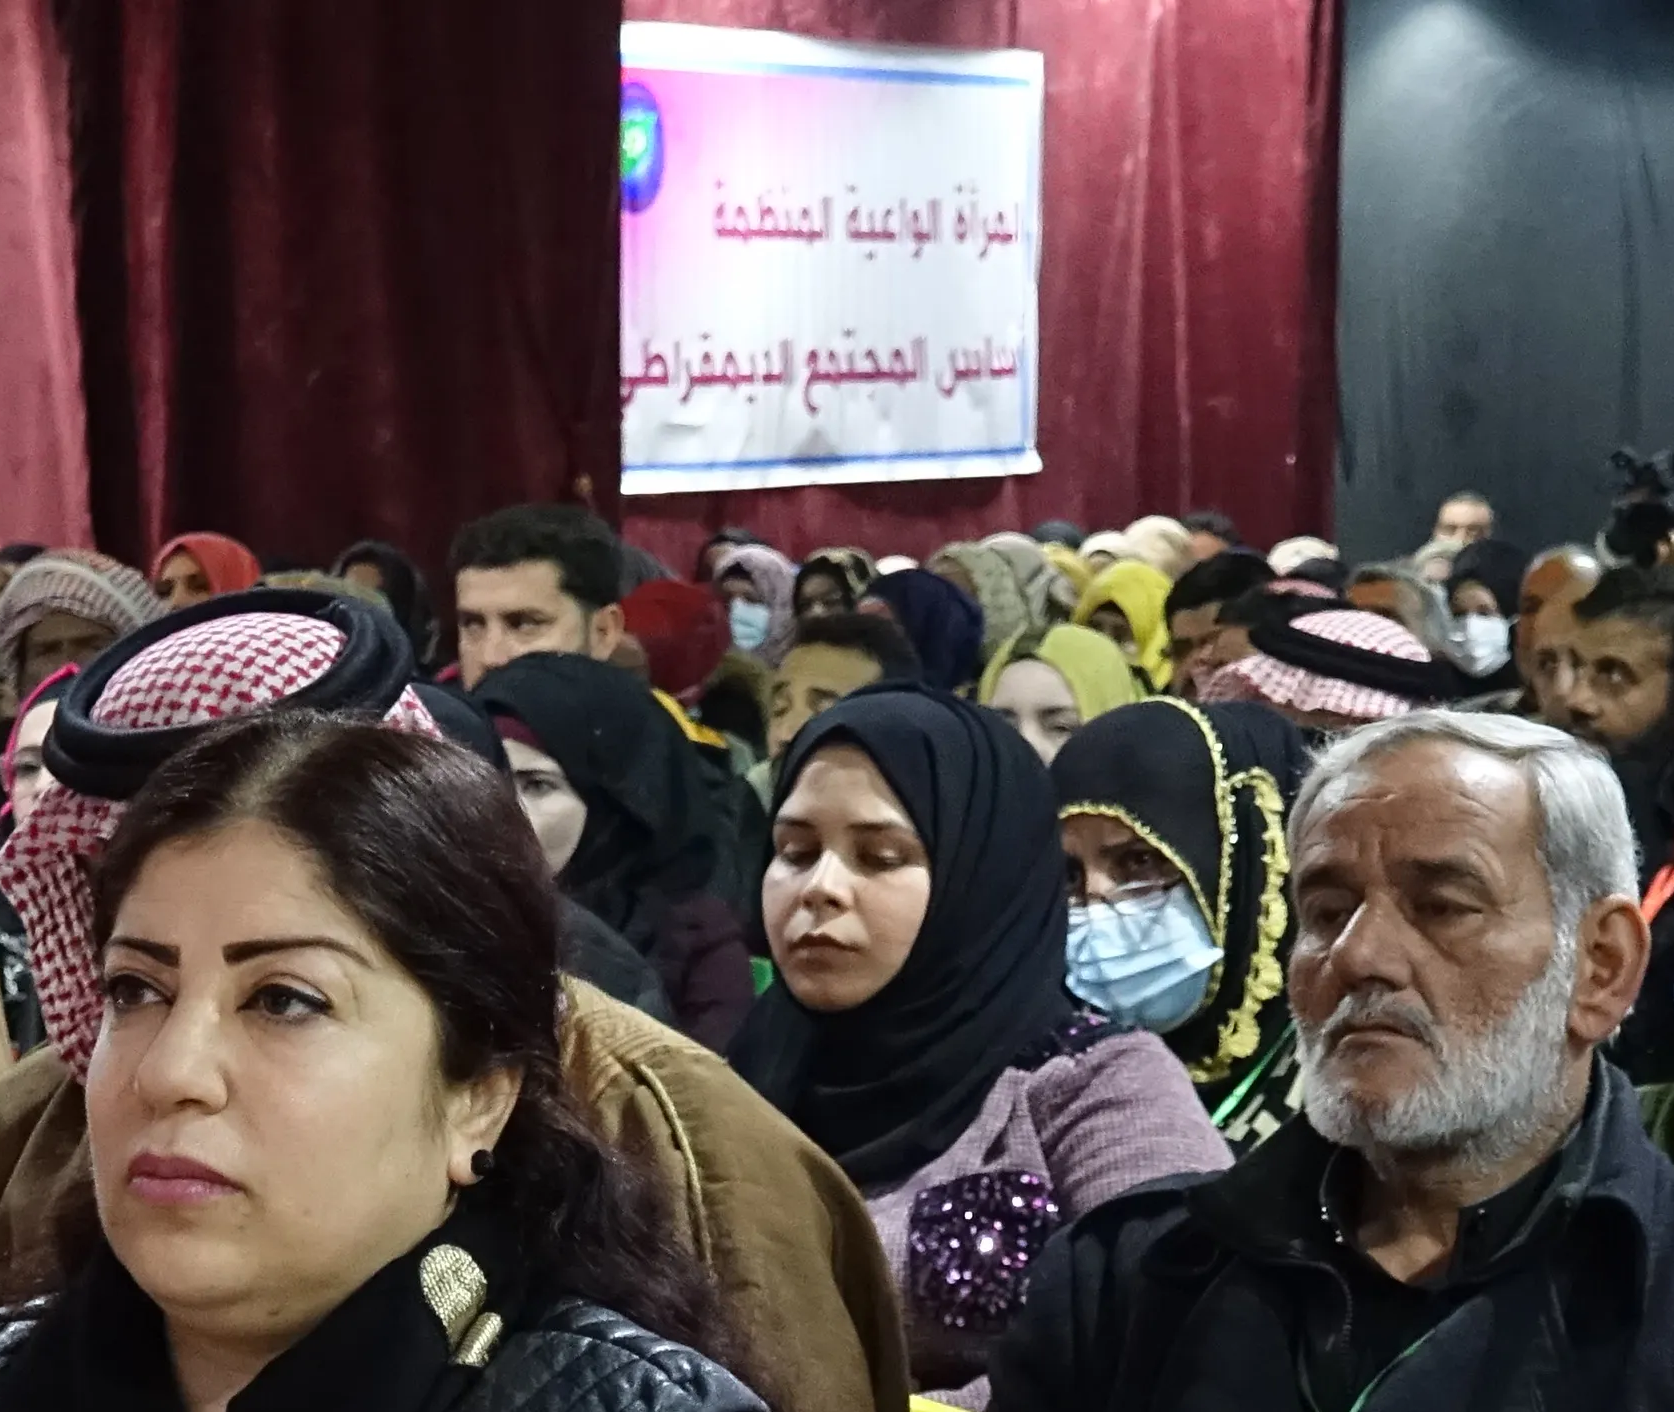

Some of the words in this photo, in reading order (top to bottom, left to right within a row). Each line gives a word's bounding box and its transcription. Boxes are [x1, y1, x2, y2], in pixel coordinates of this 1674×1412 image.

[715, 178, 834, 246] المنظمة
[845, 183, 942, 260] الواعية
[950, 182, 1019, 260] لمرأة
[804, 327, 928, 416] المجتمع
[935, 336, 1017, 399] ساس
